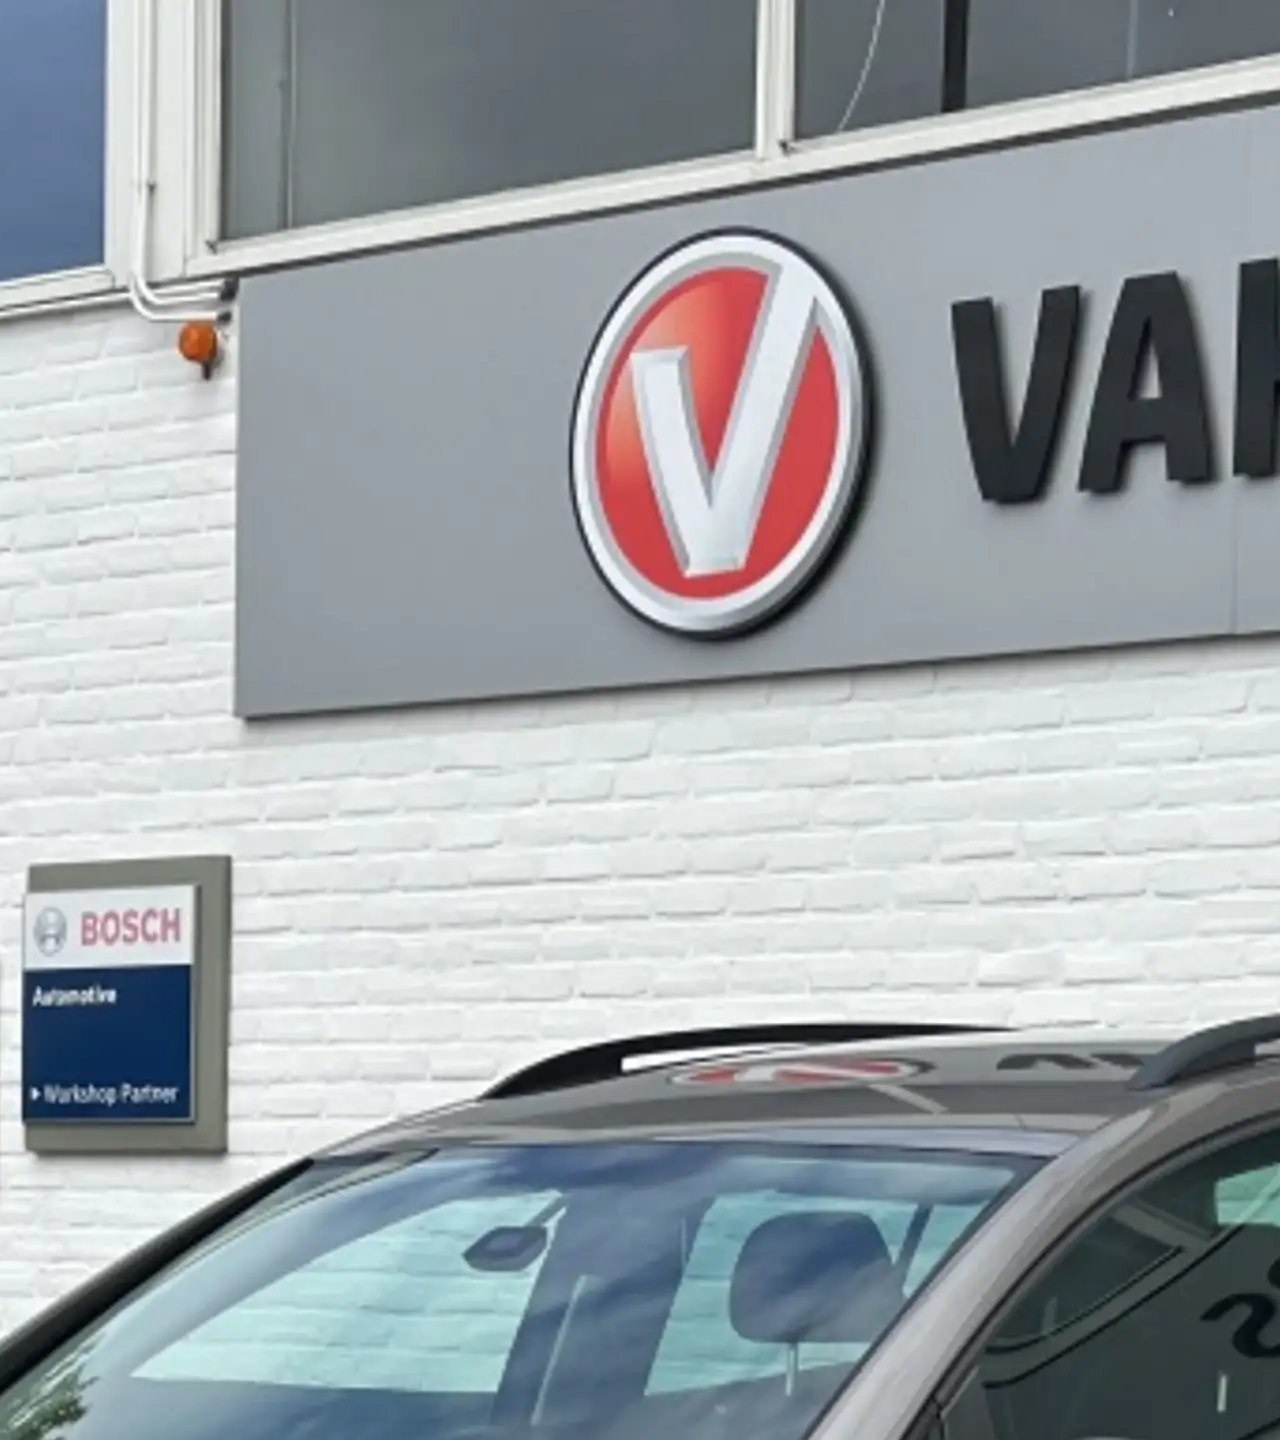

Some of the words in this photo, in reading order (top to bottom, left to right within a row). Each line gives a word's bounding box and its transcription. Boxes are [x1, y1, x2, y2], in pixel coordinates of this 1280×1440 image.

[80, 908, 181, 947] BOSCH
[32, 984, 117, 1007] Automotive
[43, 1083, 116, 1107] Workshop
[121, 1082, 179, 1103] Partner
